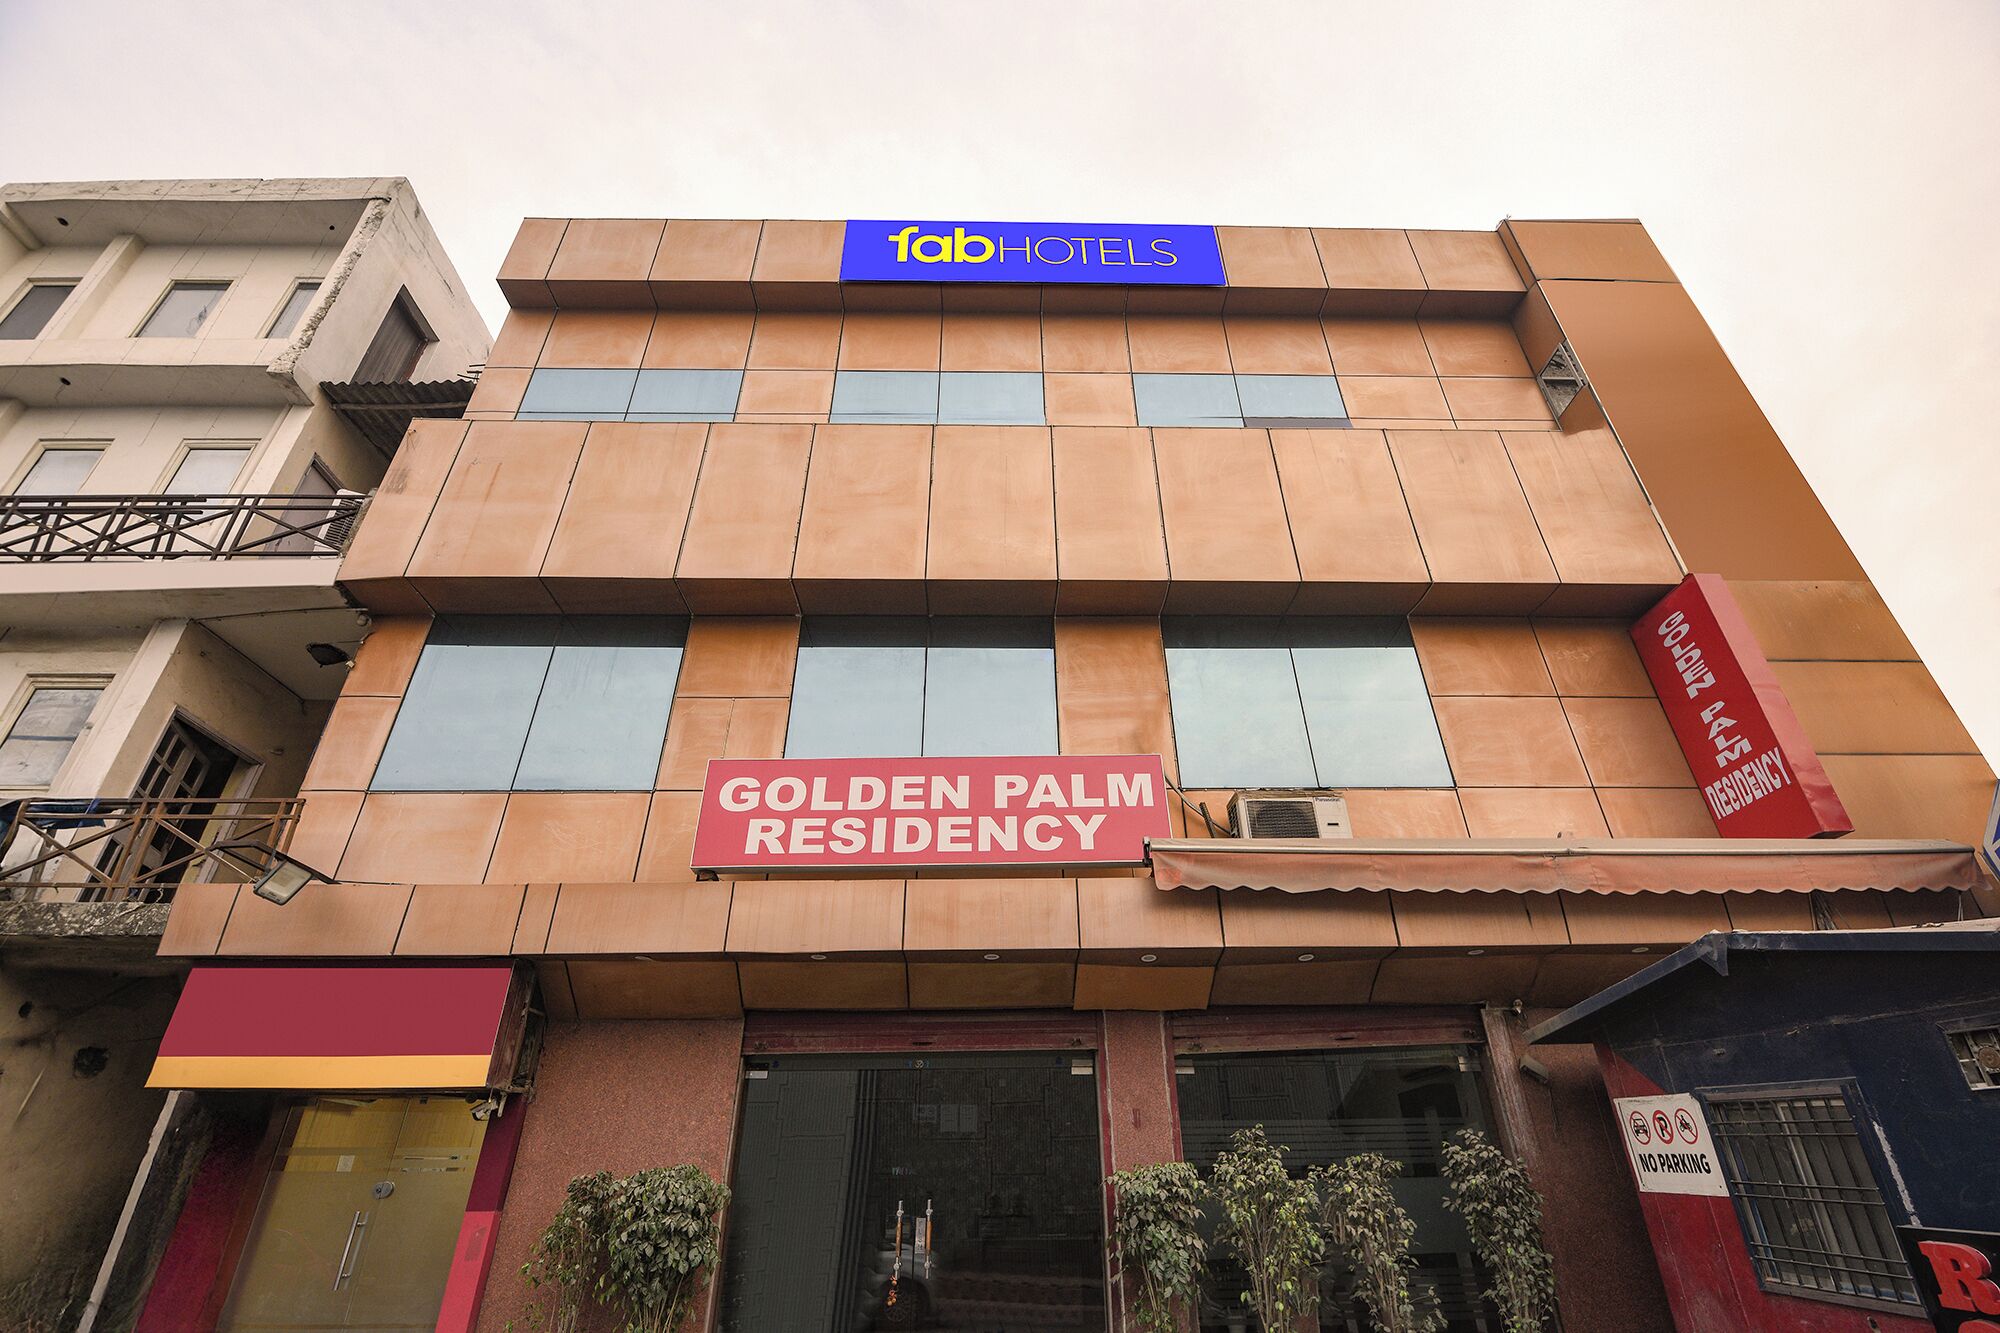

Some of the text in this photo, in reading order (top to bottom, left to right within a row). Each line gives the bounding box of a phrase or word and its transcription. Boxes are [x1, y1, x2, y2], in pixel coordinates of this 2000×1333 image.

[1657, 610, 1752, 768] GOLDEN PALM
[718, 773, 1154, 812] GOLDEN PALM
[1705, 747, 1792, 820] RESIDENCY
[744, 814, 1107, 854] RESIDENCY
[1639, 1153, 1711, 1174] NO PARKING
